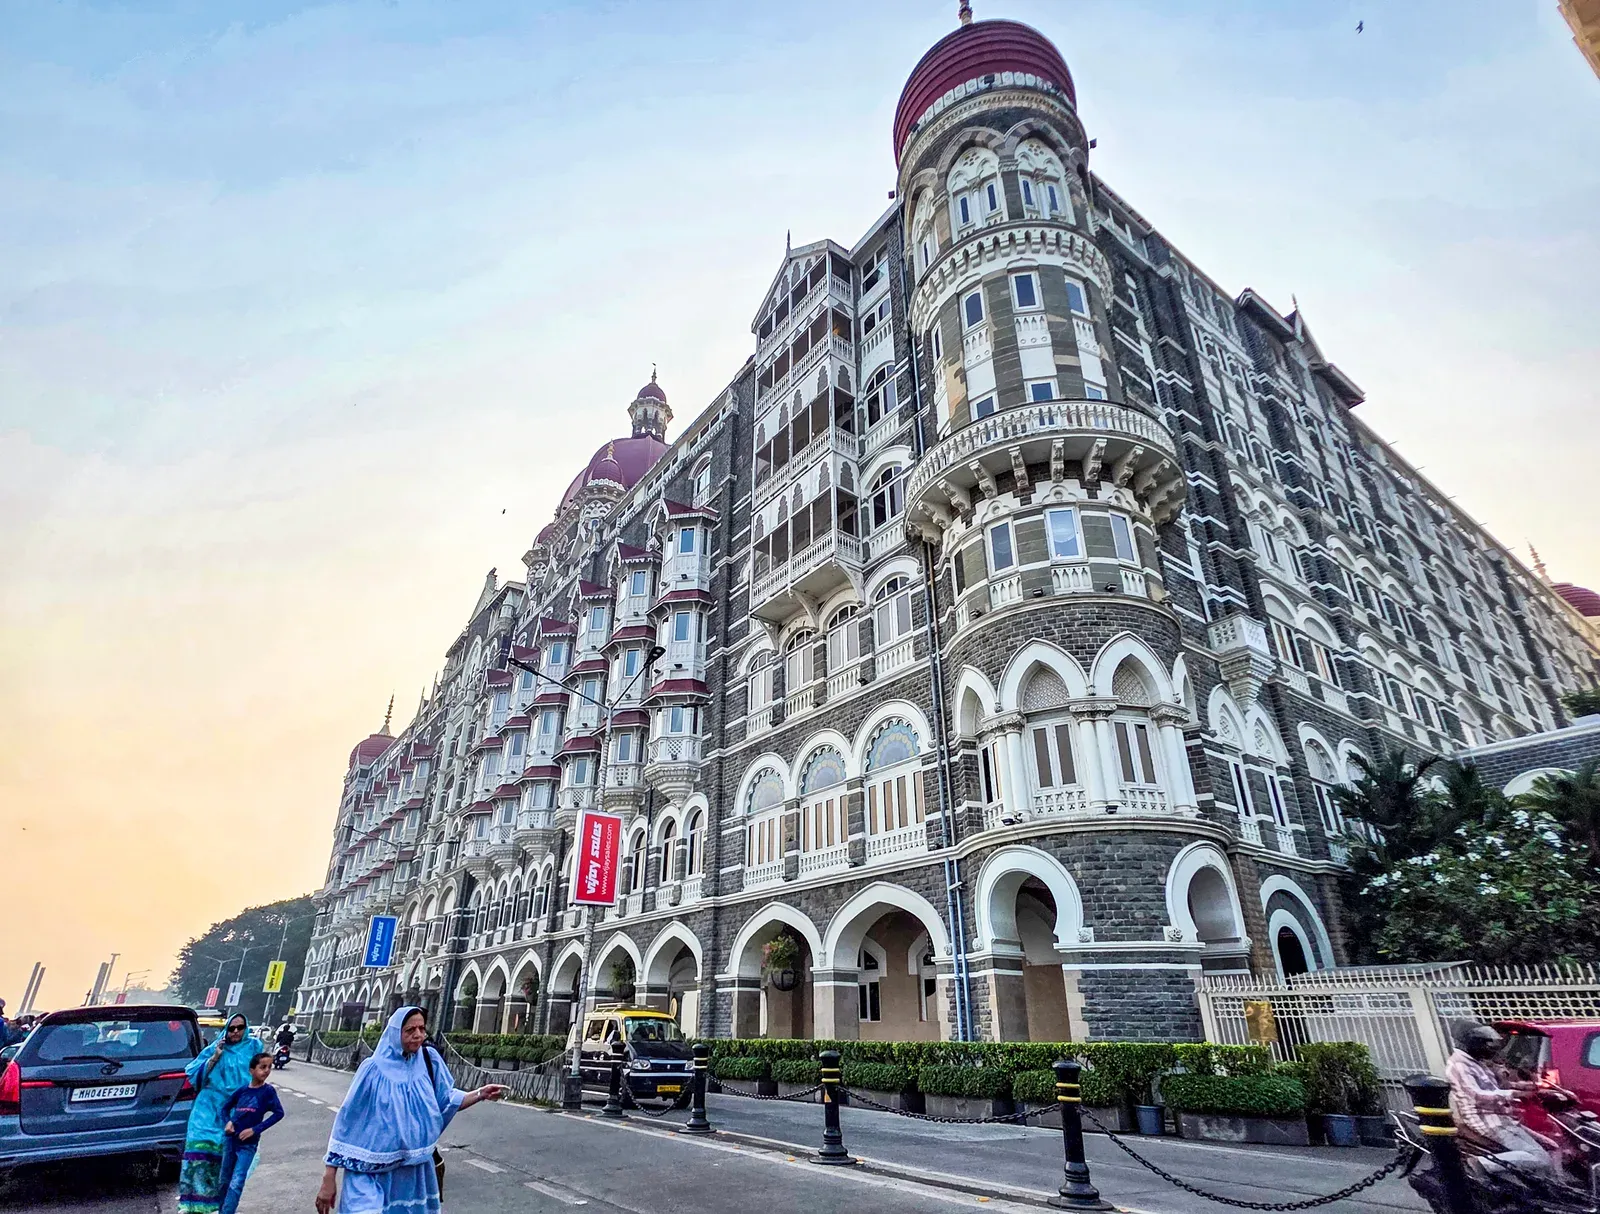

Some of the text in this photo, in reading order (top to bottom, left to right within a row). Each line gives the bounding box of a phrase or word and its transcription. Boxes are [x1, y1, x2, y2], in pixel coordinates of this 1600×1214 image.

[585, 821, 602, 895] vijay sales
[601, 823, 613, 895] www.vijaysales.com
[78, 1086, 136, 1099] MH04EF2989
